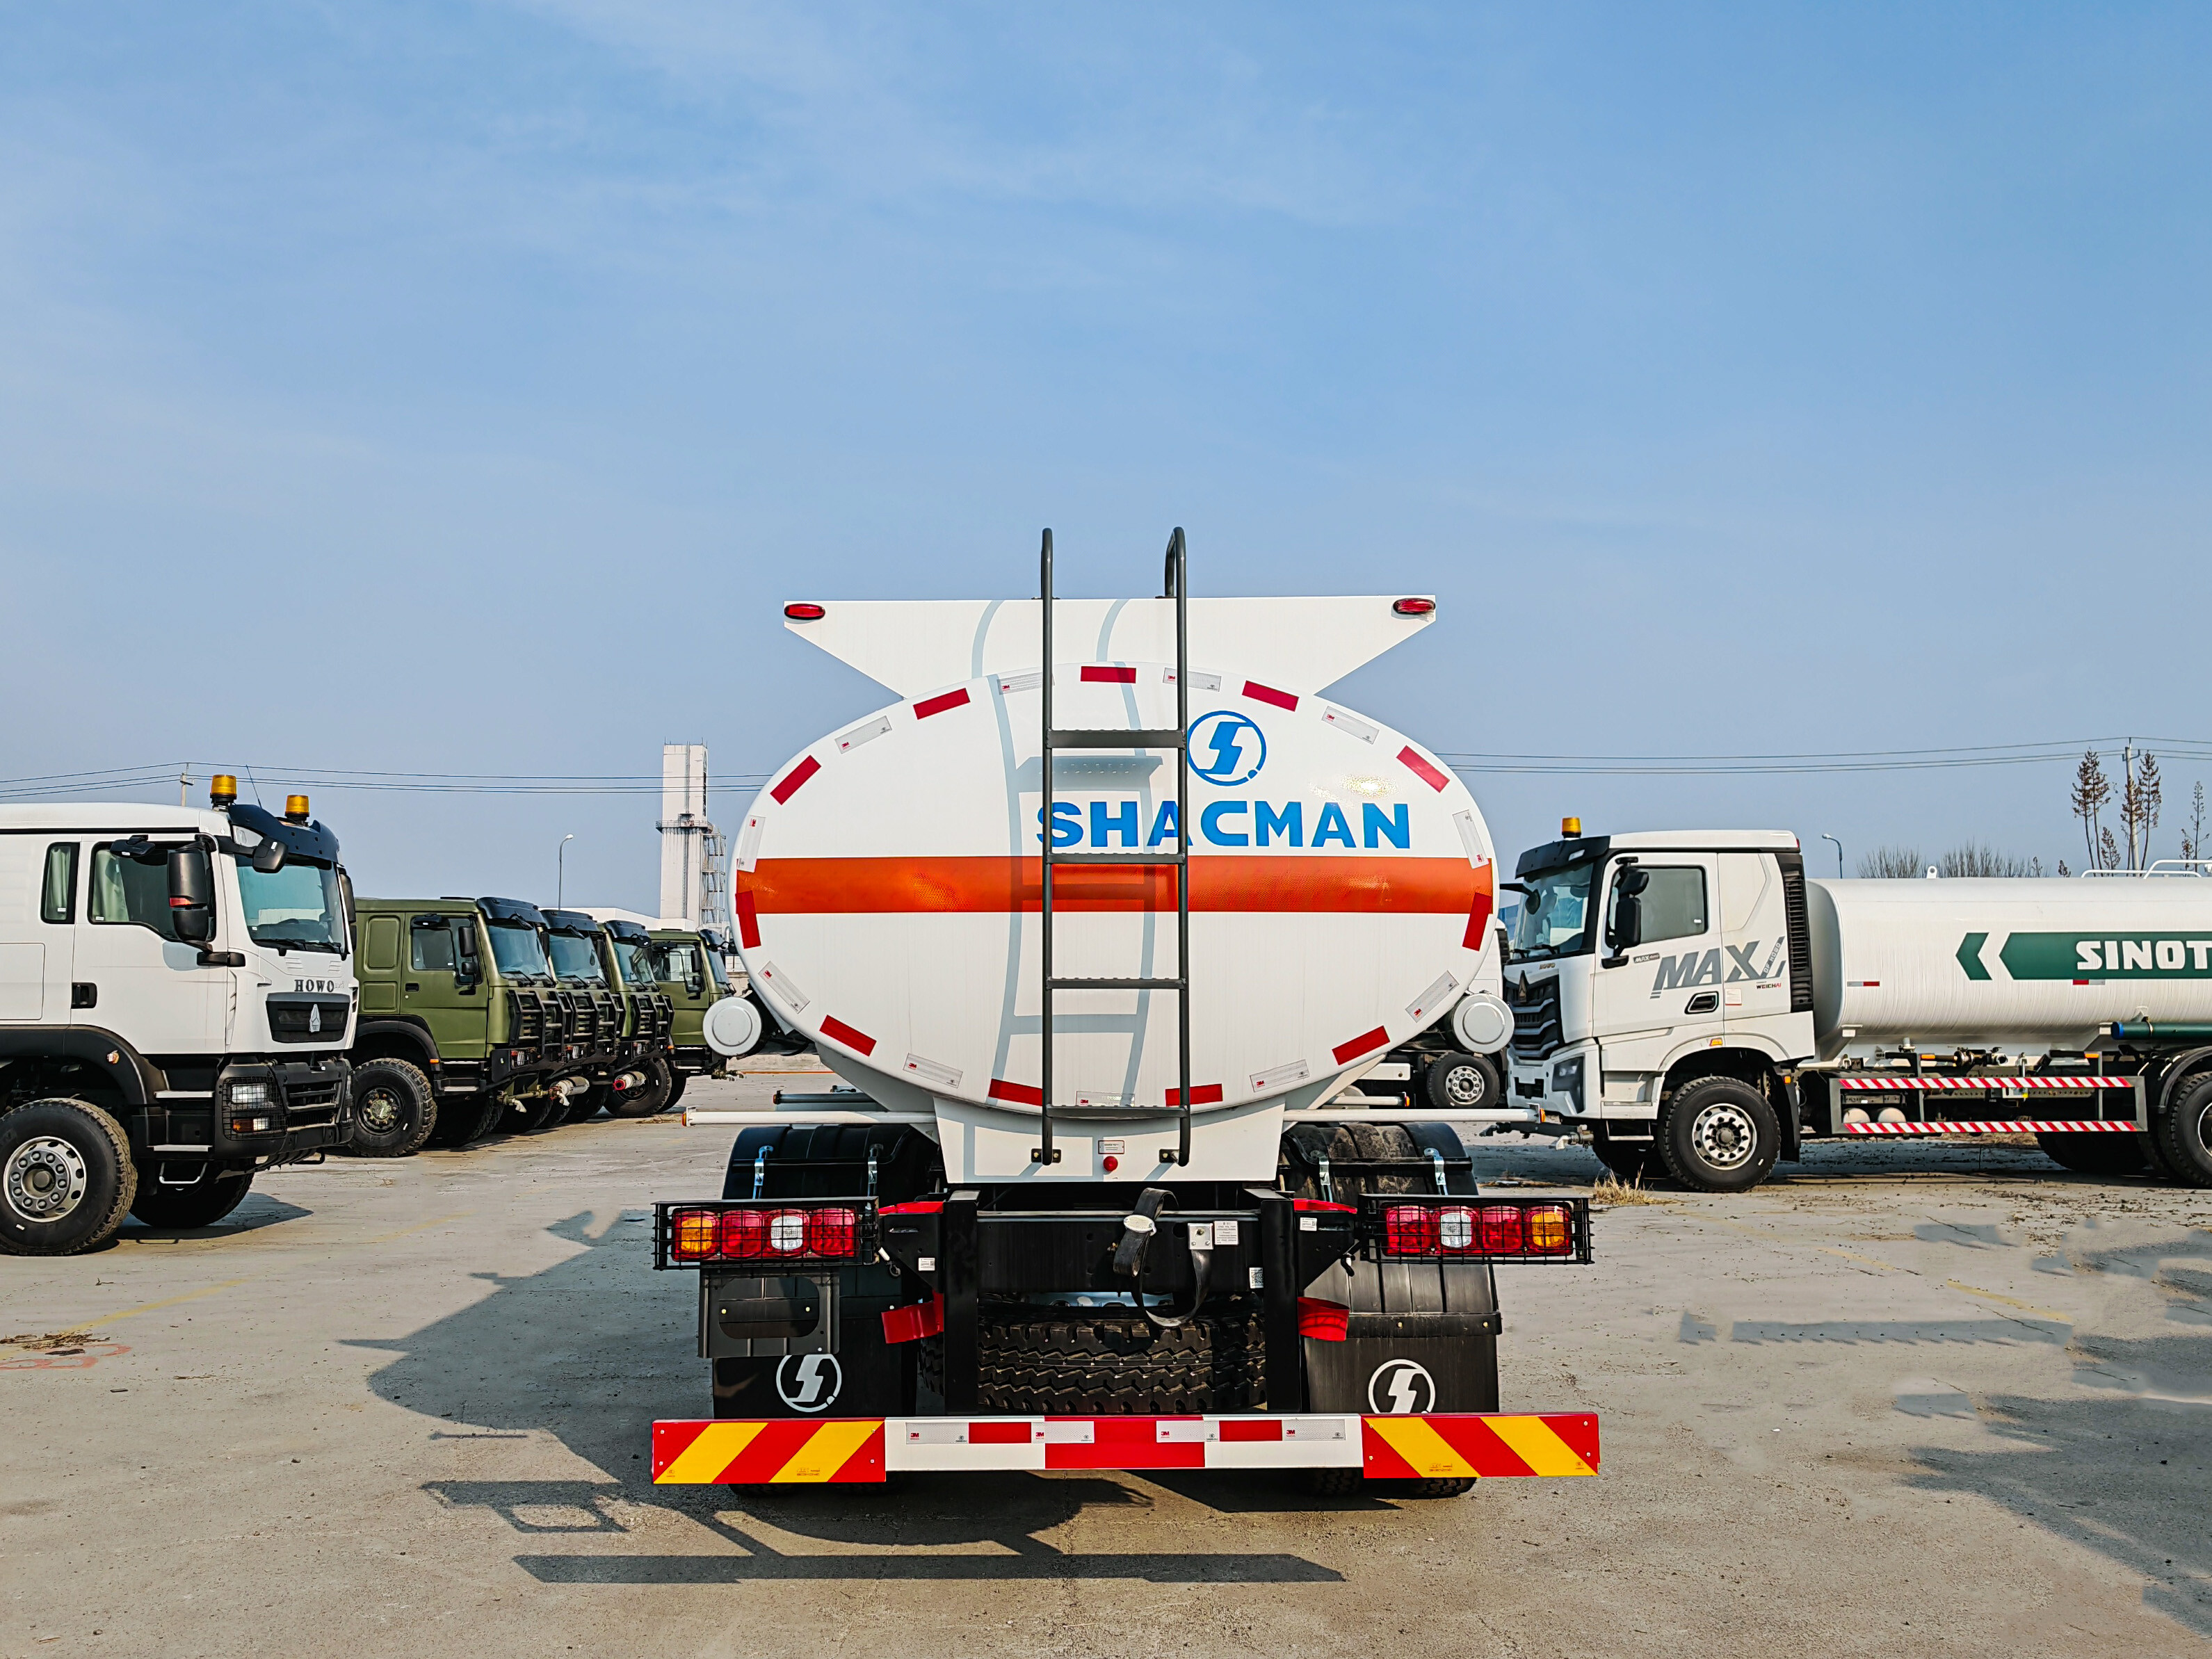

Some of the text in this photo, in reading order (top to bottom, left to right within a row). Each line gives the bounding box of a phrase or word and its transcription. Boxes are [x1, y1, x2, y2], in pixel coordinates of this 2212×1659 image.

[1037, 801, 1410, 849] SHACMAN
[1652, 940, 1761, 992] MAX
[2076, 940, 2212, 970] SINOT
[294, 979, 334, 993] HOWO
